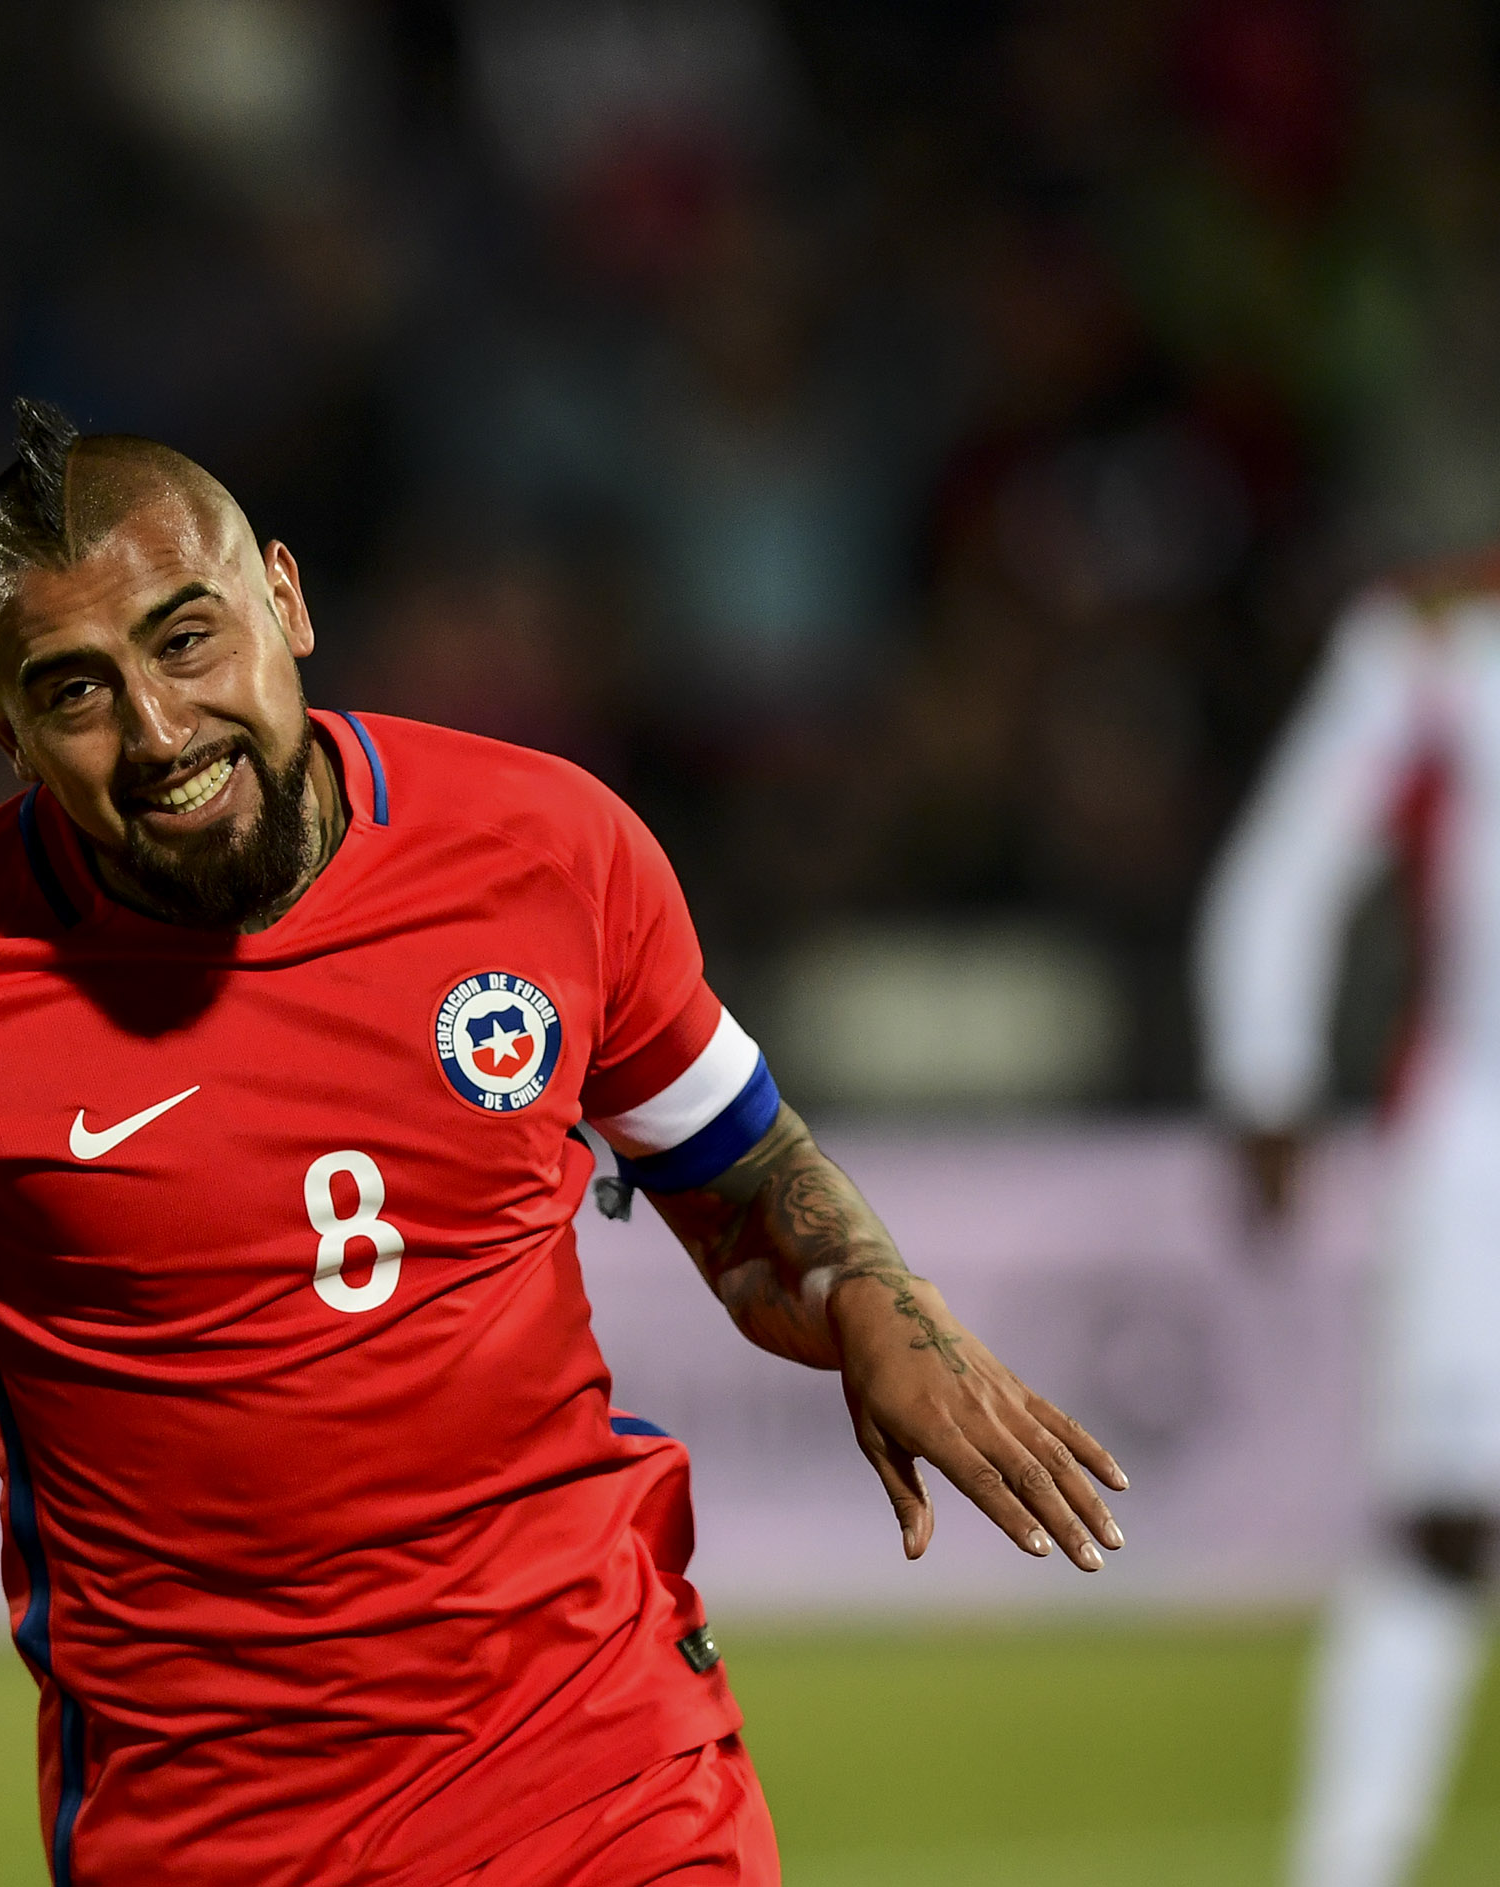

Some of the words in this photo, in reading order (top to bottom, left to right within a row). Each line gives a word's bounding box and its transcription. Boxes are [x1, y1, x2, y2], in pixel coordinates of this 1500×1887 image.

[436, 977, 482, 1060] FEDERACION
[488, 973, 508, 990] DE
[513, 979, 558, 1029] FUTBOL
[303, 1149, 405, 1313] 8
